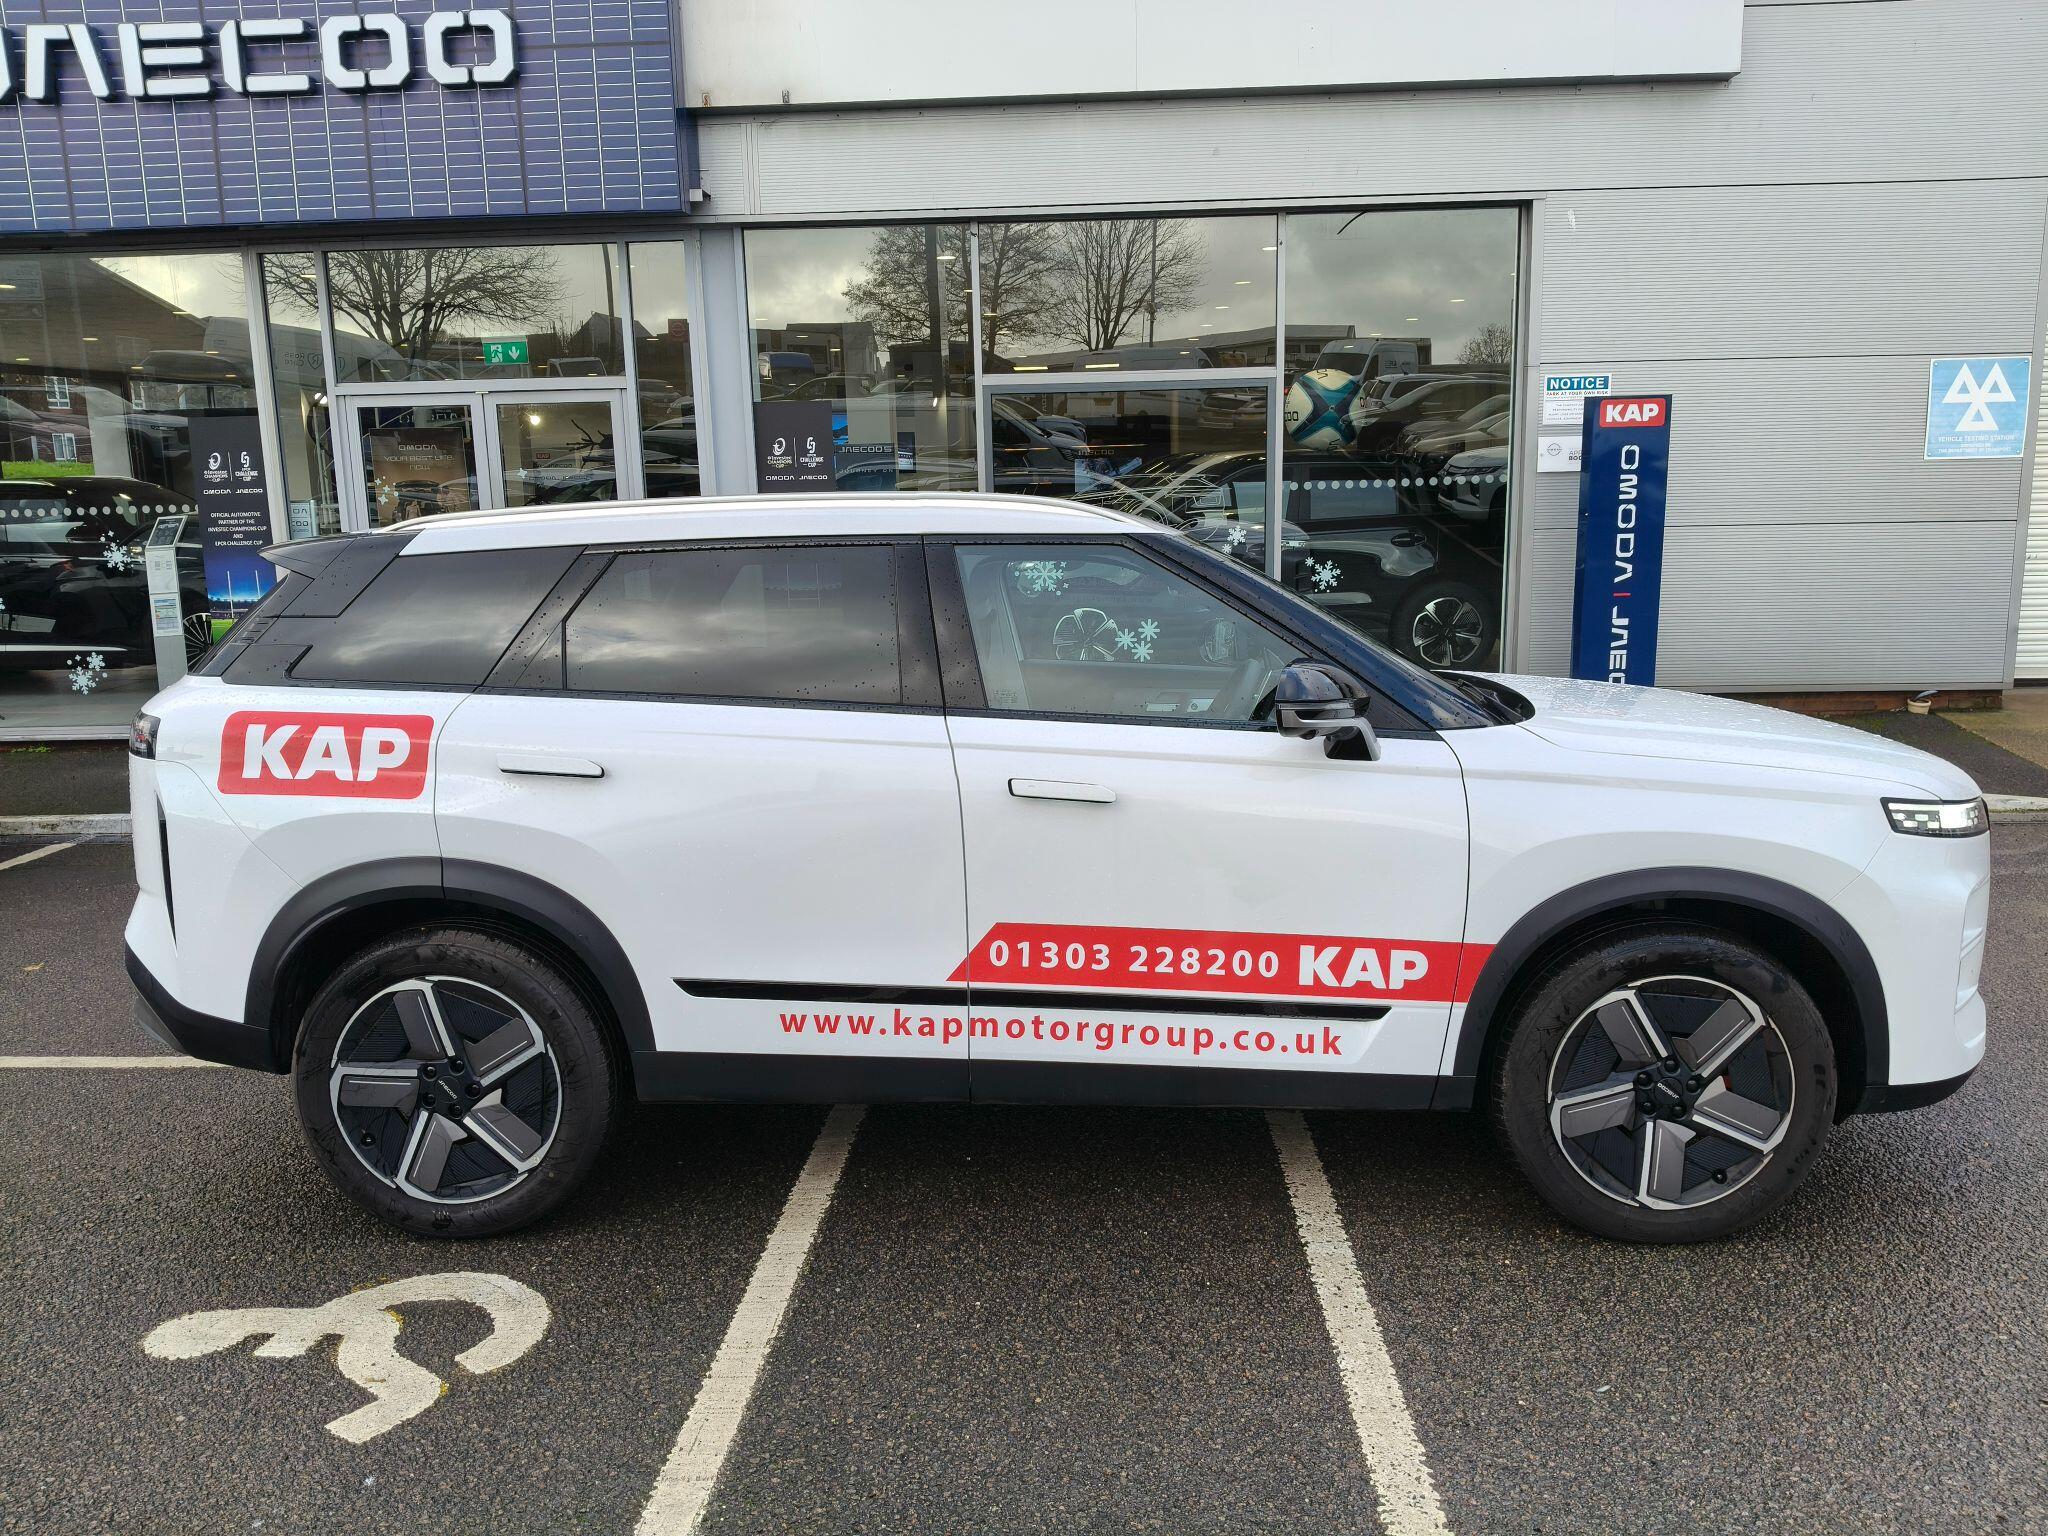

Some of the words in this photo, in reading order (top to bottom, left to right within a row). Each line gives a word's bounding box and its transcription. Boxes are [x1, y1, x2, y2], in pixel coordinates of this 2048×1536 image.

[0, 9, 517, 100] AECOO
[1550, 377, 1605, 390] NOTICE
[1605, 403, 1660, 423] KAP
[1613, 444, 1640, 584] OMODA
[242, 723, 411, 782] KAP
[989, 939, 1110, 971] 01303
[1129, 945, 1280, 978] 228200
[1298, 944, 1429, 990] KAP
[779, 1008, 1342, 1055] www.kapmotorgroup.co.uk
